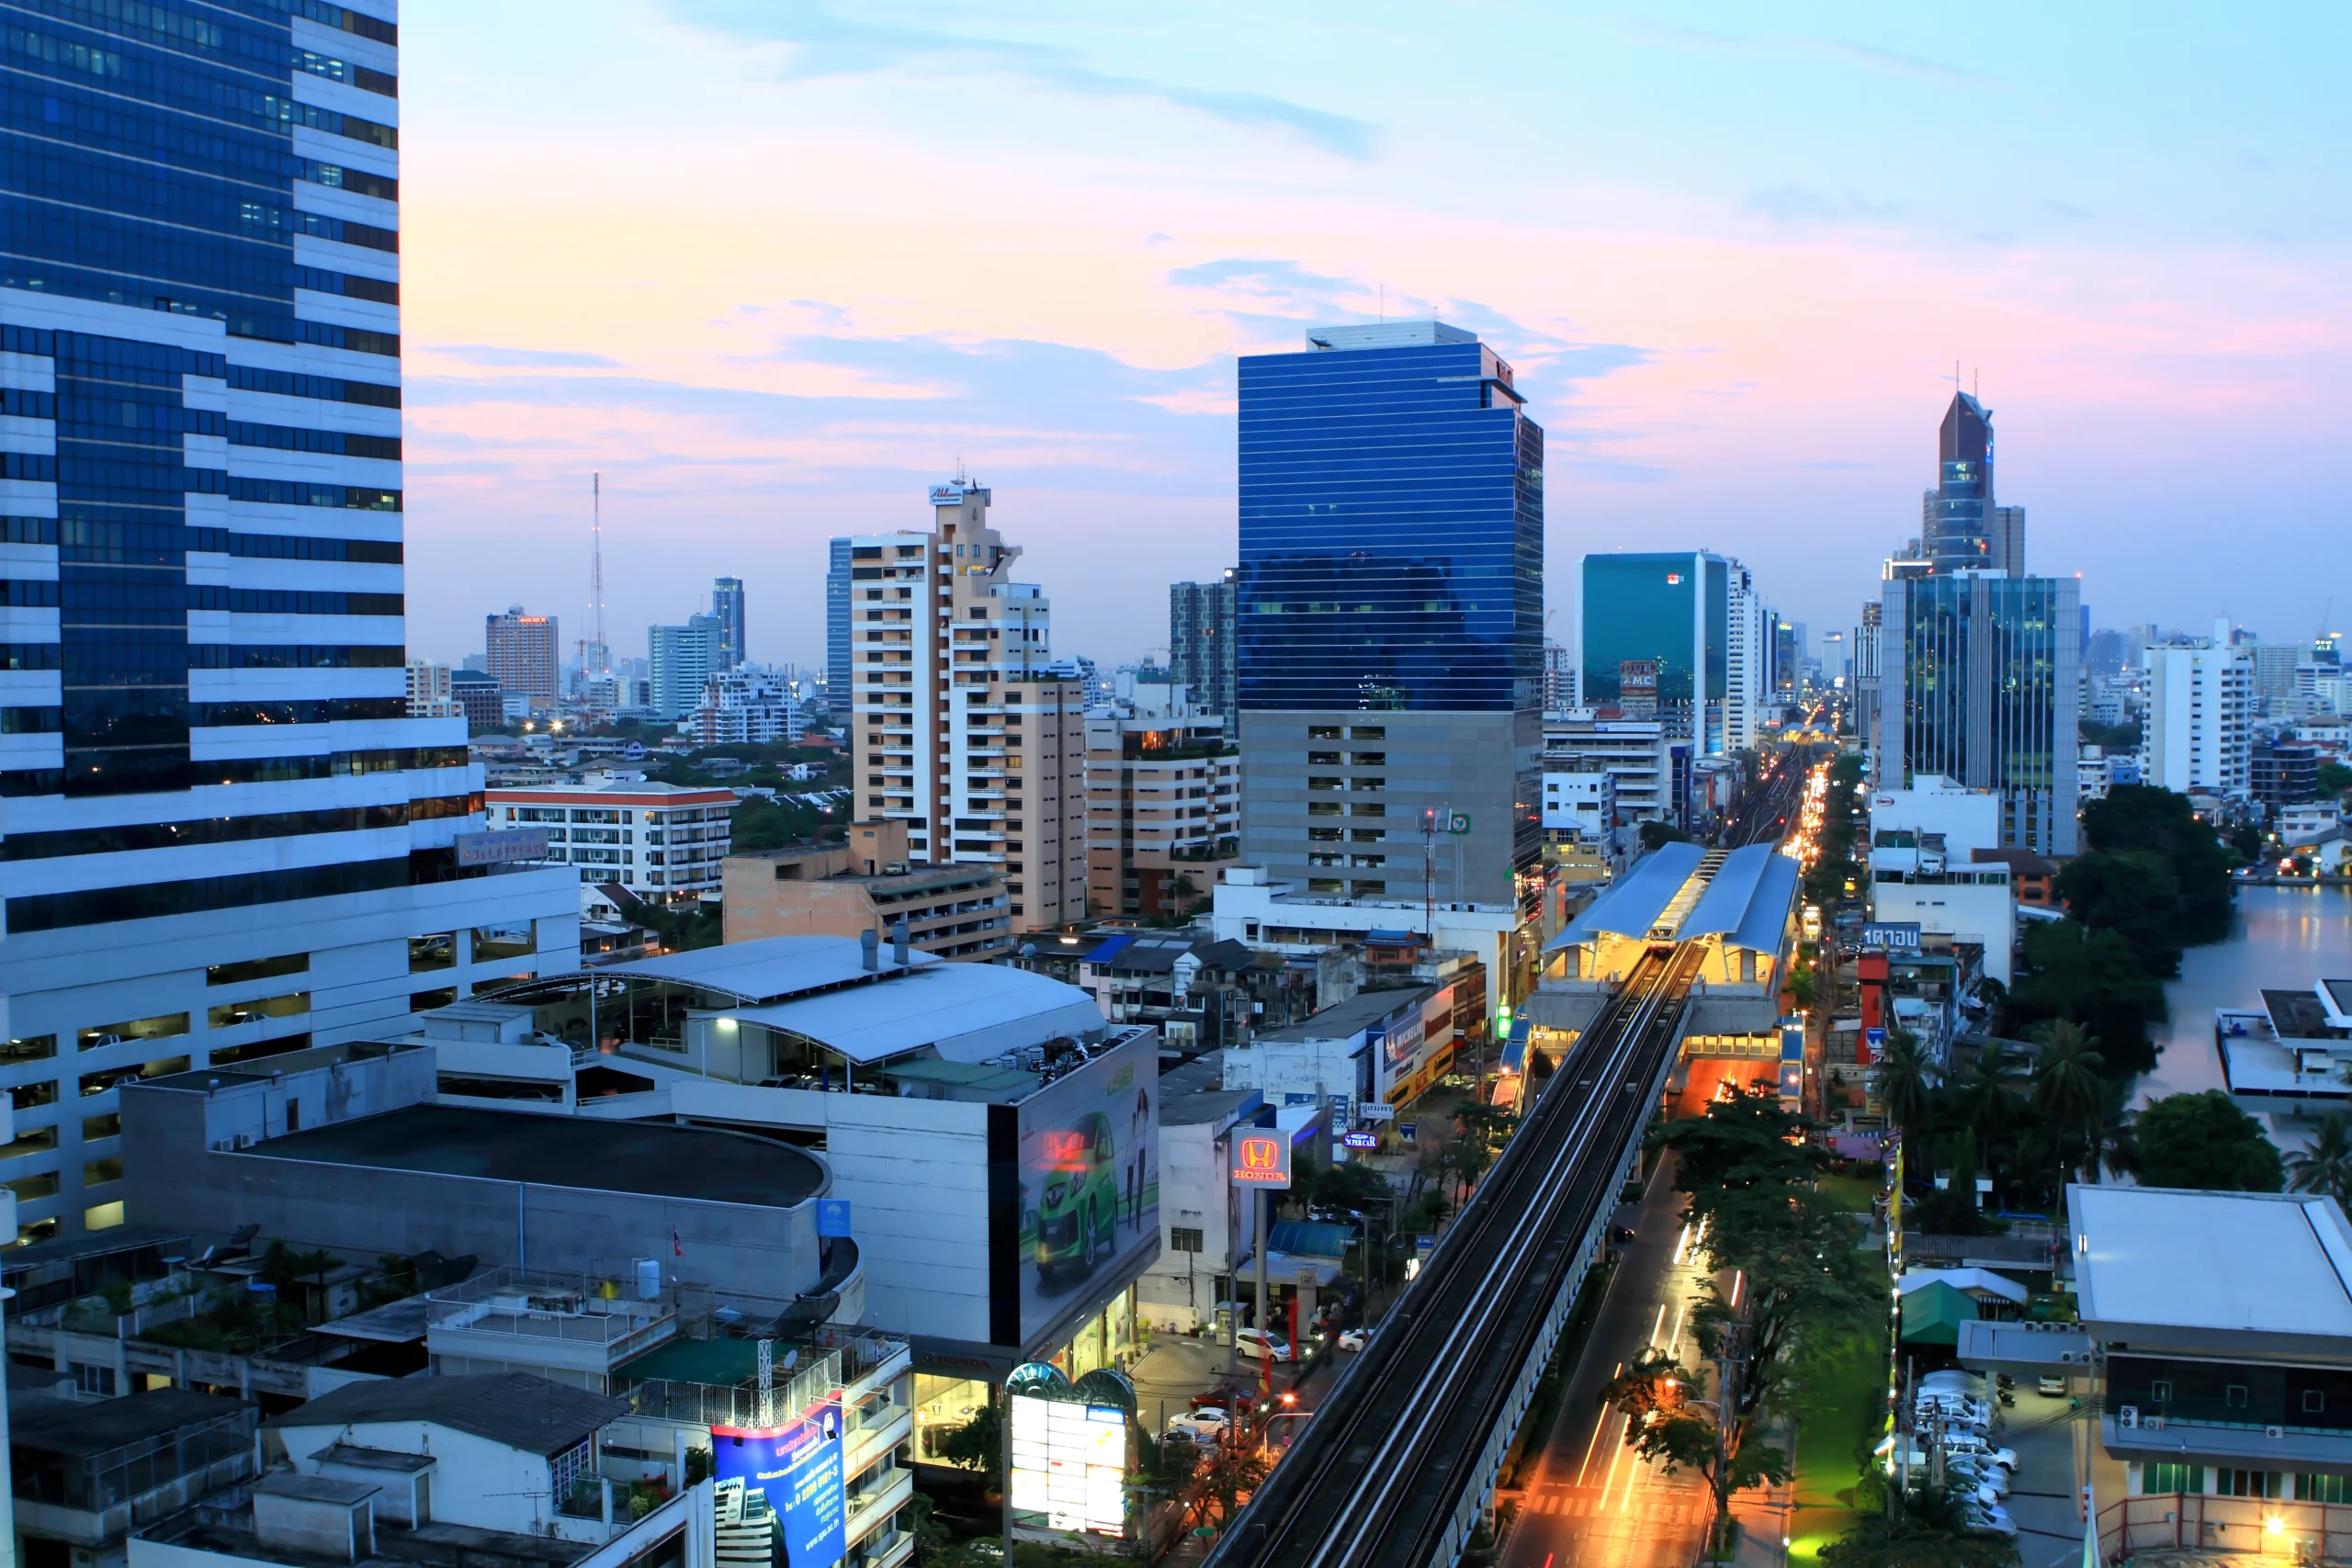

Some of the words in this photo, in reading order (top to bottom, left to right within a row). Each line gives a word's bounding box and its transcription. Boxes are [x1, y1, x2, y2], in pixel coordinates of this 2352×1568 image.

[1623, 675, 1652, 685] AMC
[1396, 1021, 1422, 1048] MICHELIN
[1344, 1134, 1363, 1146] SUPER
[1363, 1135, 1376, 1147] CAR
[1233, 1169, 1286, 1181] HONDA
[936, 1355, 990, 1369] HONDA
